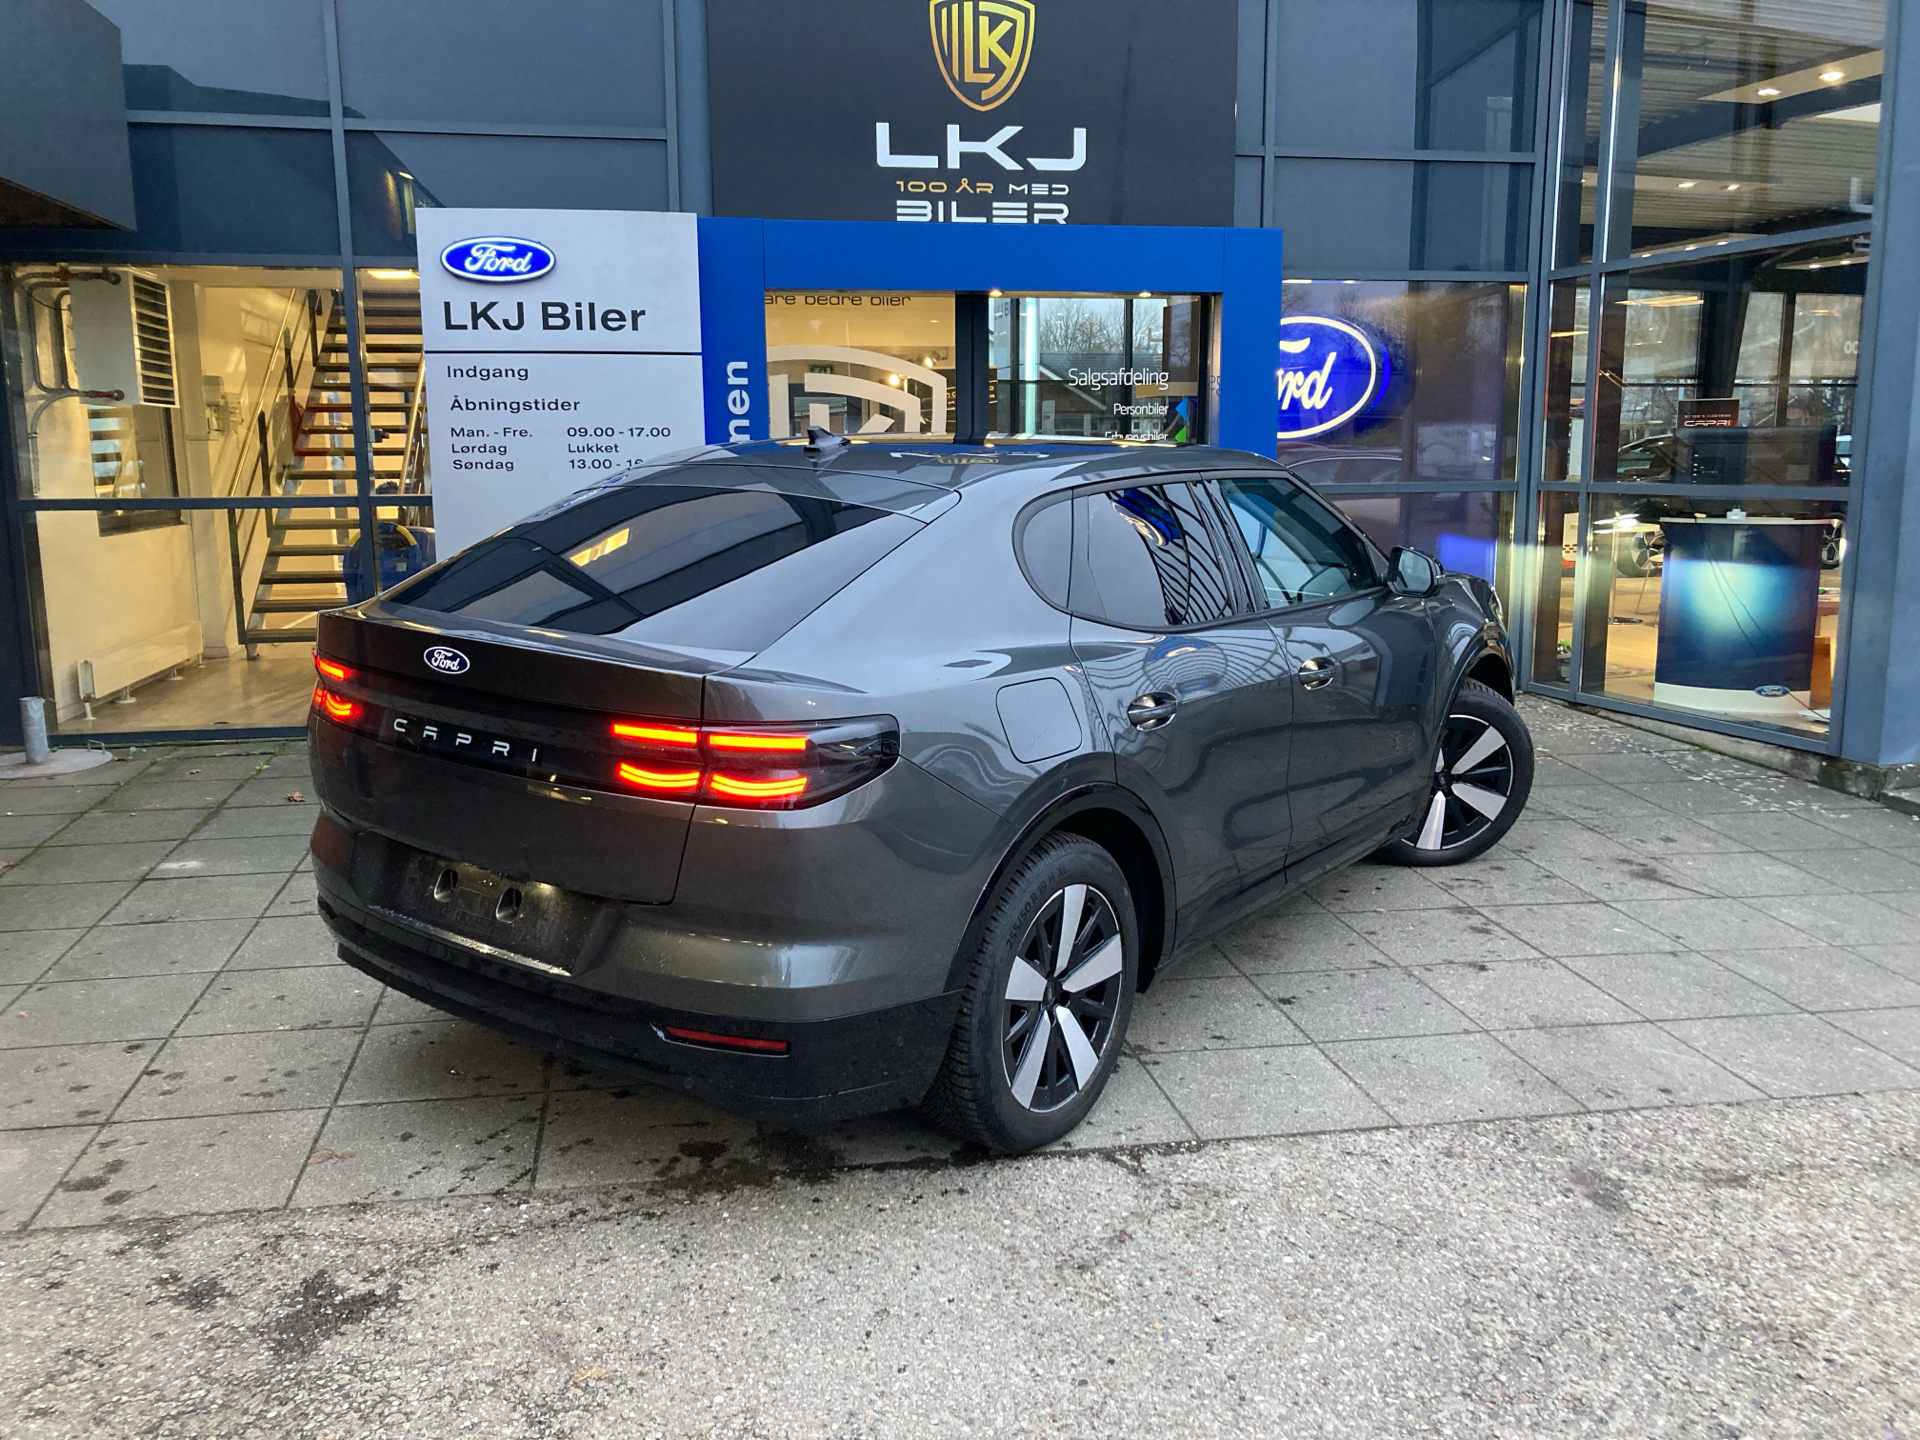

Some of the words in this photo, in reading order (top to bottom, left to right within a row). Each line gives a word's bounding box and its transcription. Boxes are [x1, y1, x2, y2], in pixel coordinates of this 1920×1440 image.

[876, 122, 1087, 171] LKJ
[896, 180, 947, 193] 100
[955, 178, 994, 194] ÅR
[1009, 183, 1070, 195] MED
[896, 200, 1070, 225] BILER
[464, 243, 533, 273] Ford
[443, 301, 525, 331] LKJ
[541, 302, 647, 332] Biler
[447, 365, 529, 380] Indgang
[1068, 367, 1169, 391] Salgsafdeling
[450, 395, 581, 414] Åbningstider
[1113, 402, 1169, 415] Personbiler
[450, 427, 490, 438] Man.
[503, 427, 533, 438] Fre.
[566, 427, 615, 438] 09.00
[628, 427, 671, 438] 17.00
[1684, 419, 1731, 427] CAPRI
[451, 443, 507, 456] Lørdag
[567, 443, 620, 454] Lukket
[452, 459, 514, 472] Søndag
[569, 458, 612, 469] 13.00
[430, 650, 460, 671] Ford
[393, 718, 538, 762] CAPRI
